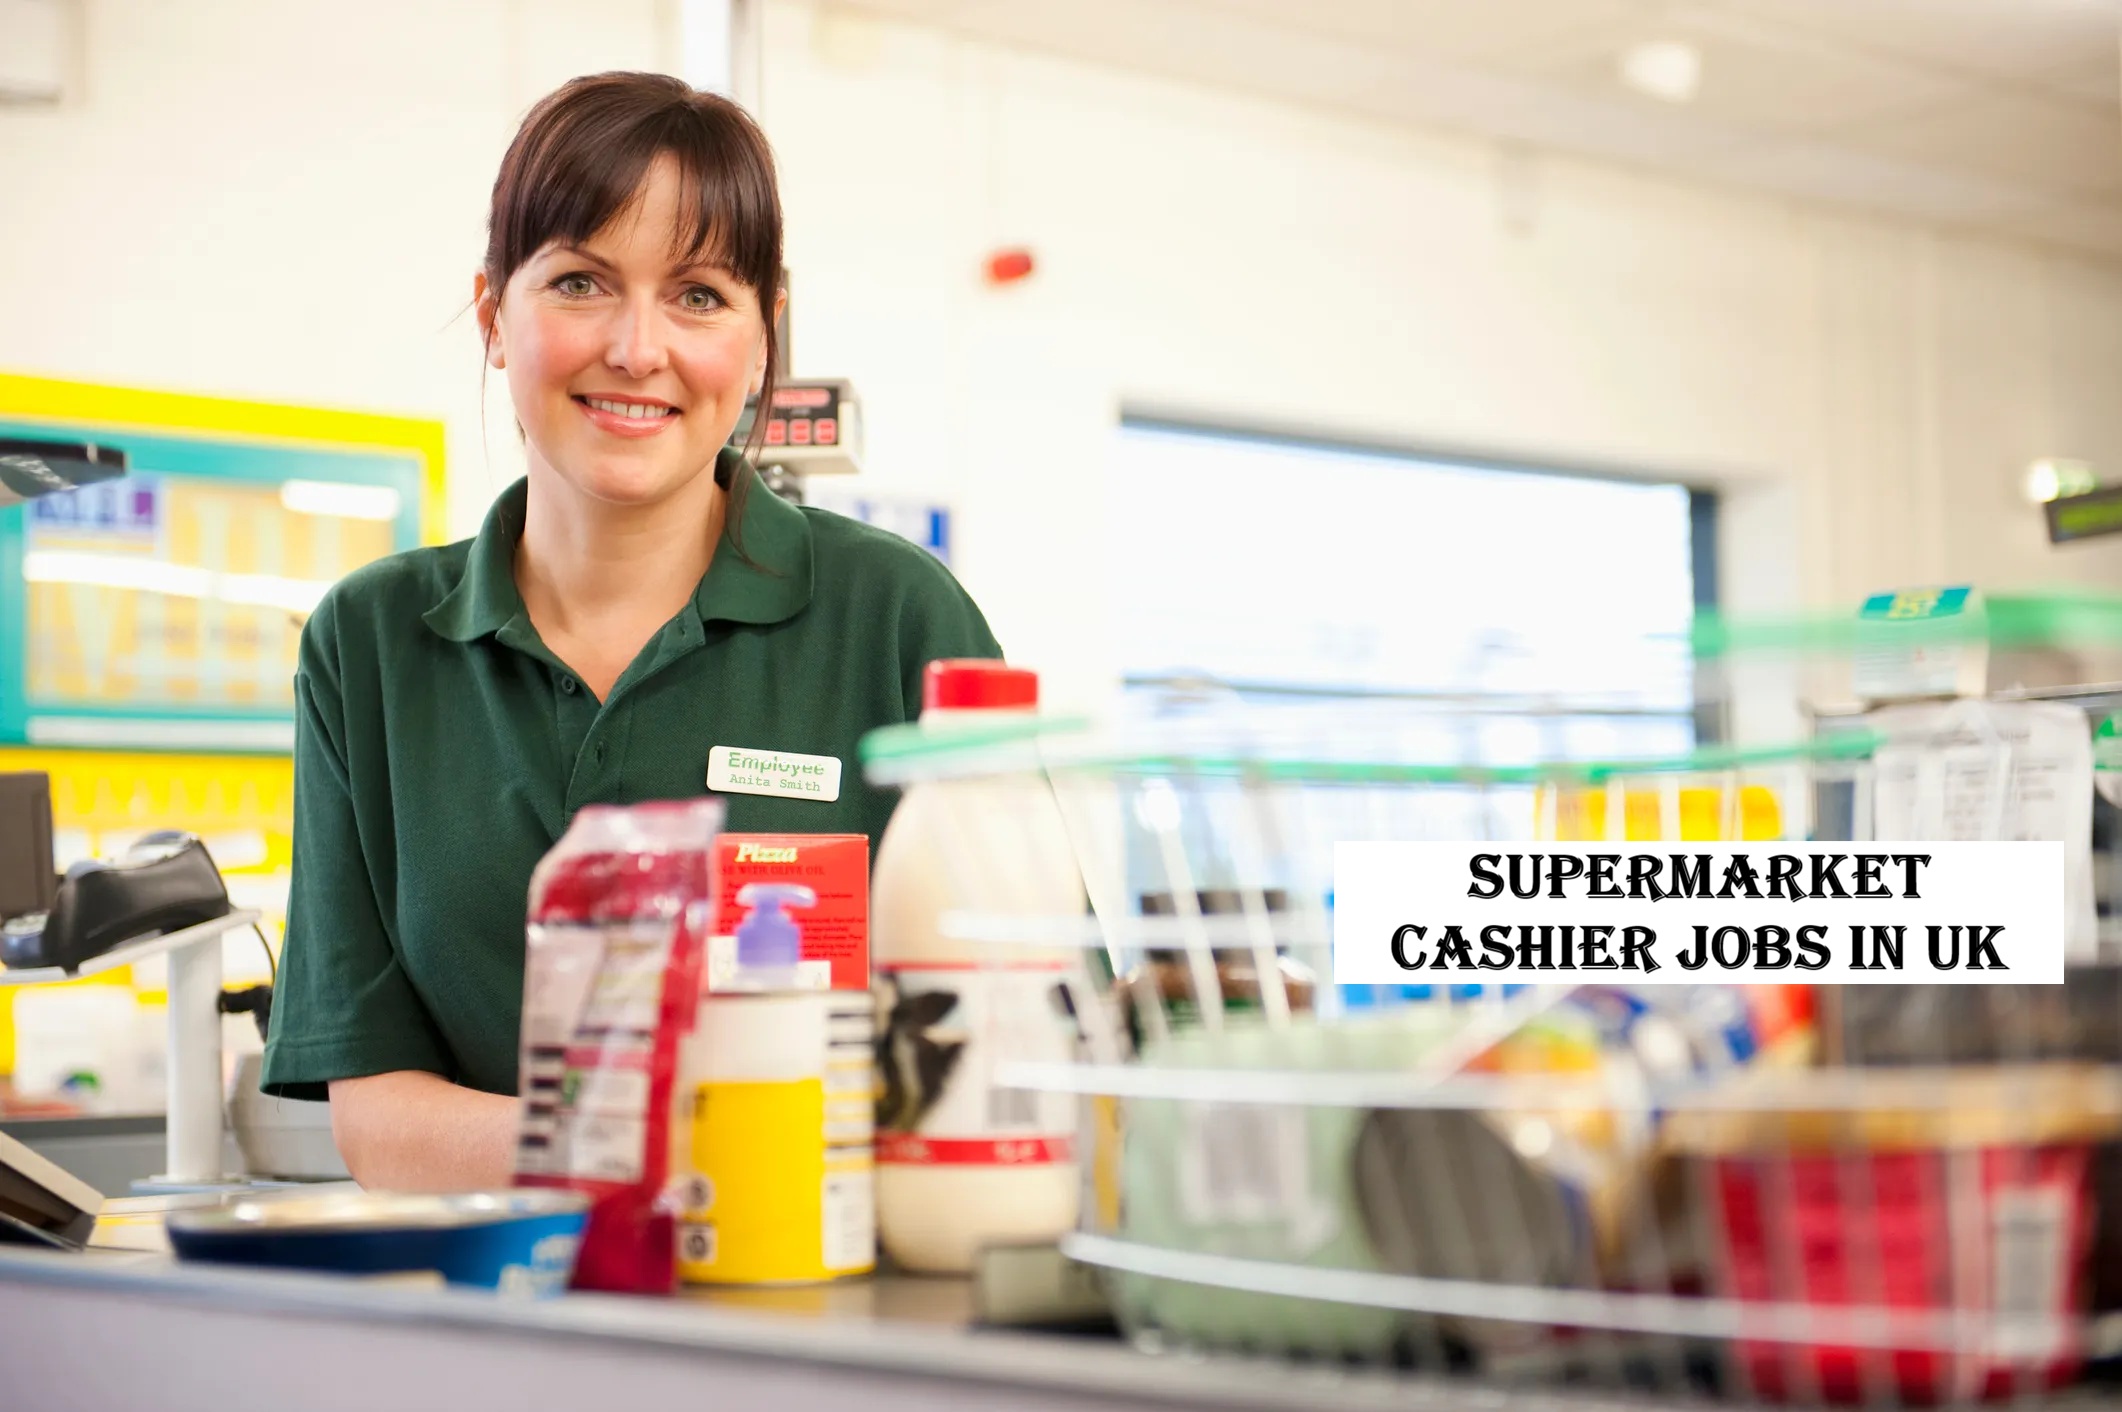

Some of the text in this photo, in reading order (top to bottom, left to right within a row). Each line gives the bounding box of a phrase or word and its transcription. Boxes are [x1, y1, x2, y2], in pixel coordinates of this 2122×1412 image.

[728, 751, 825, 777] Employee
[729, 774, 821, 792] Anita Smith
[733, 842, 798, 863] Pizza
